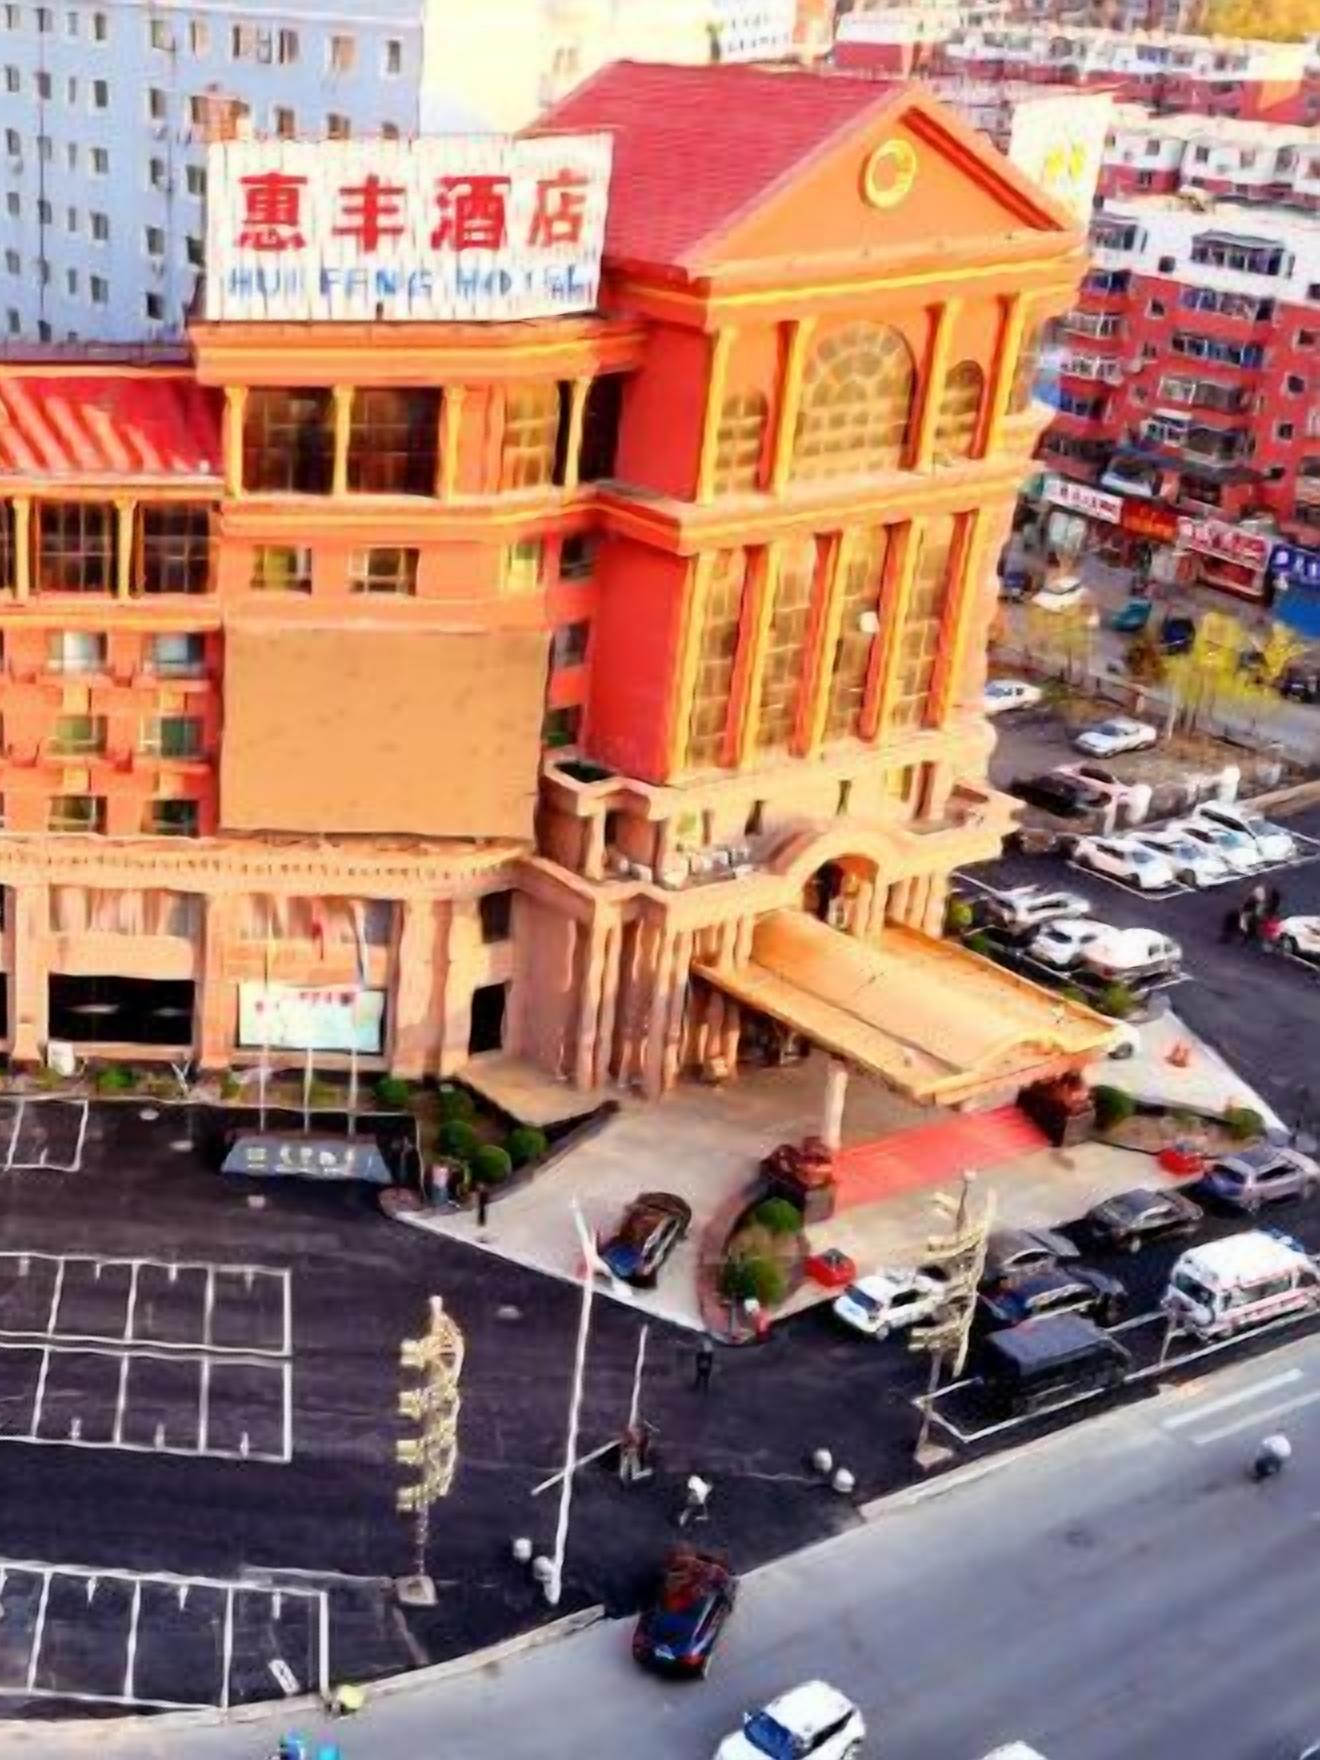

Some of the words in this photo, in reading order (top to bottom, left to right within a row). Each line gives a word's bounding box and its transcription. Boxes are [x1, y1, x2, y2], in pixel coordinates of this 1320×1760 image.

[238, 170, 589, 253] 惠丰酒店
[454, 265, 586, 302] HOEL
